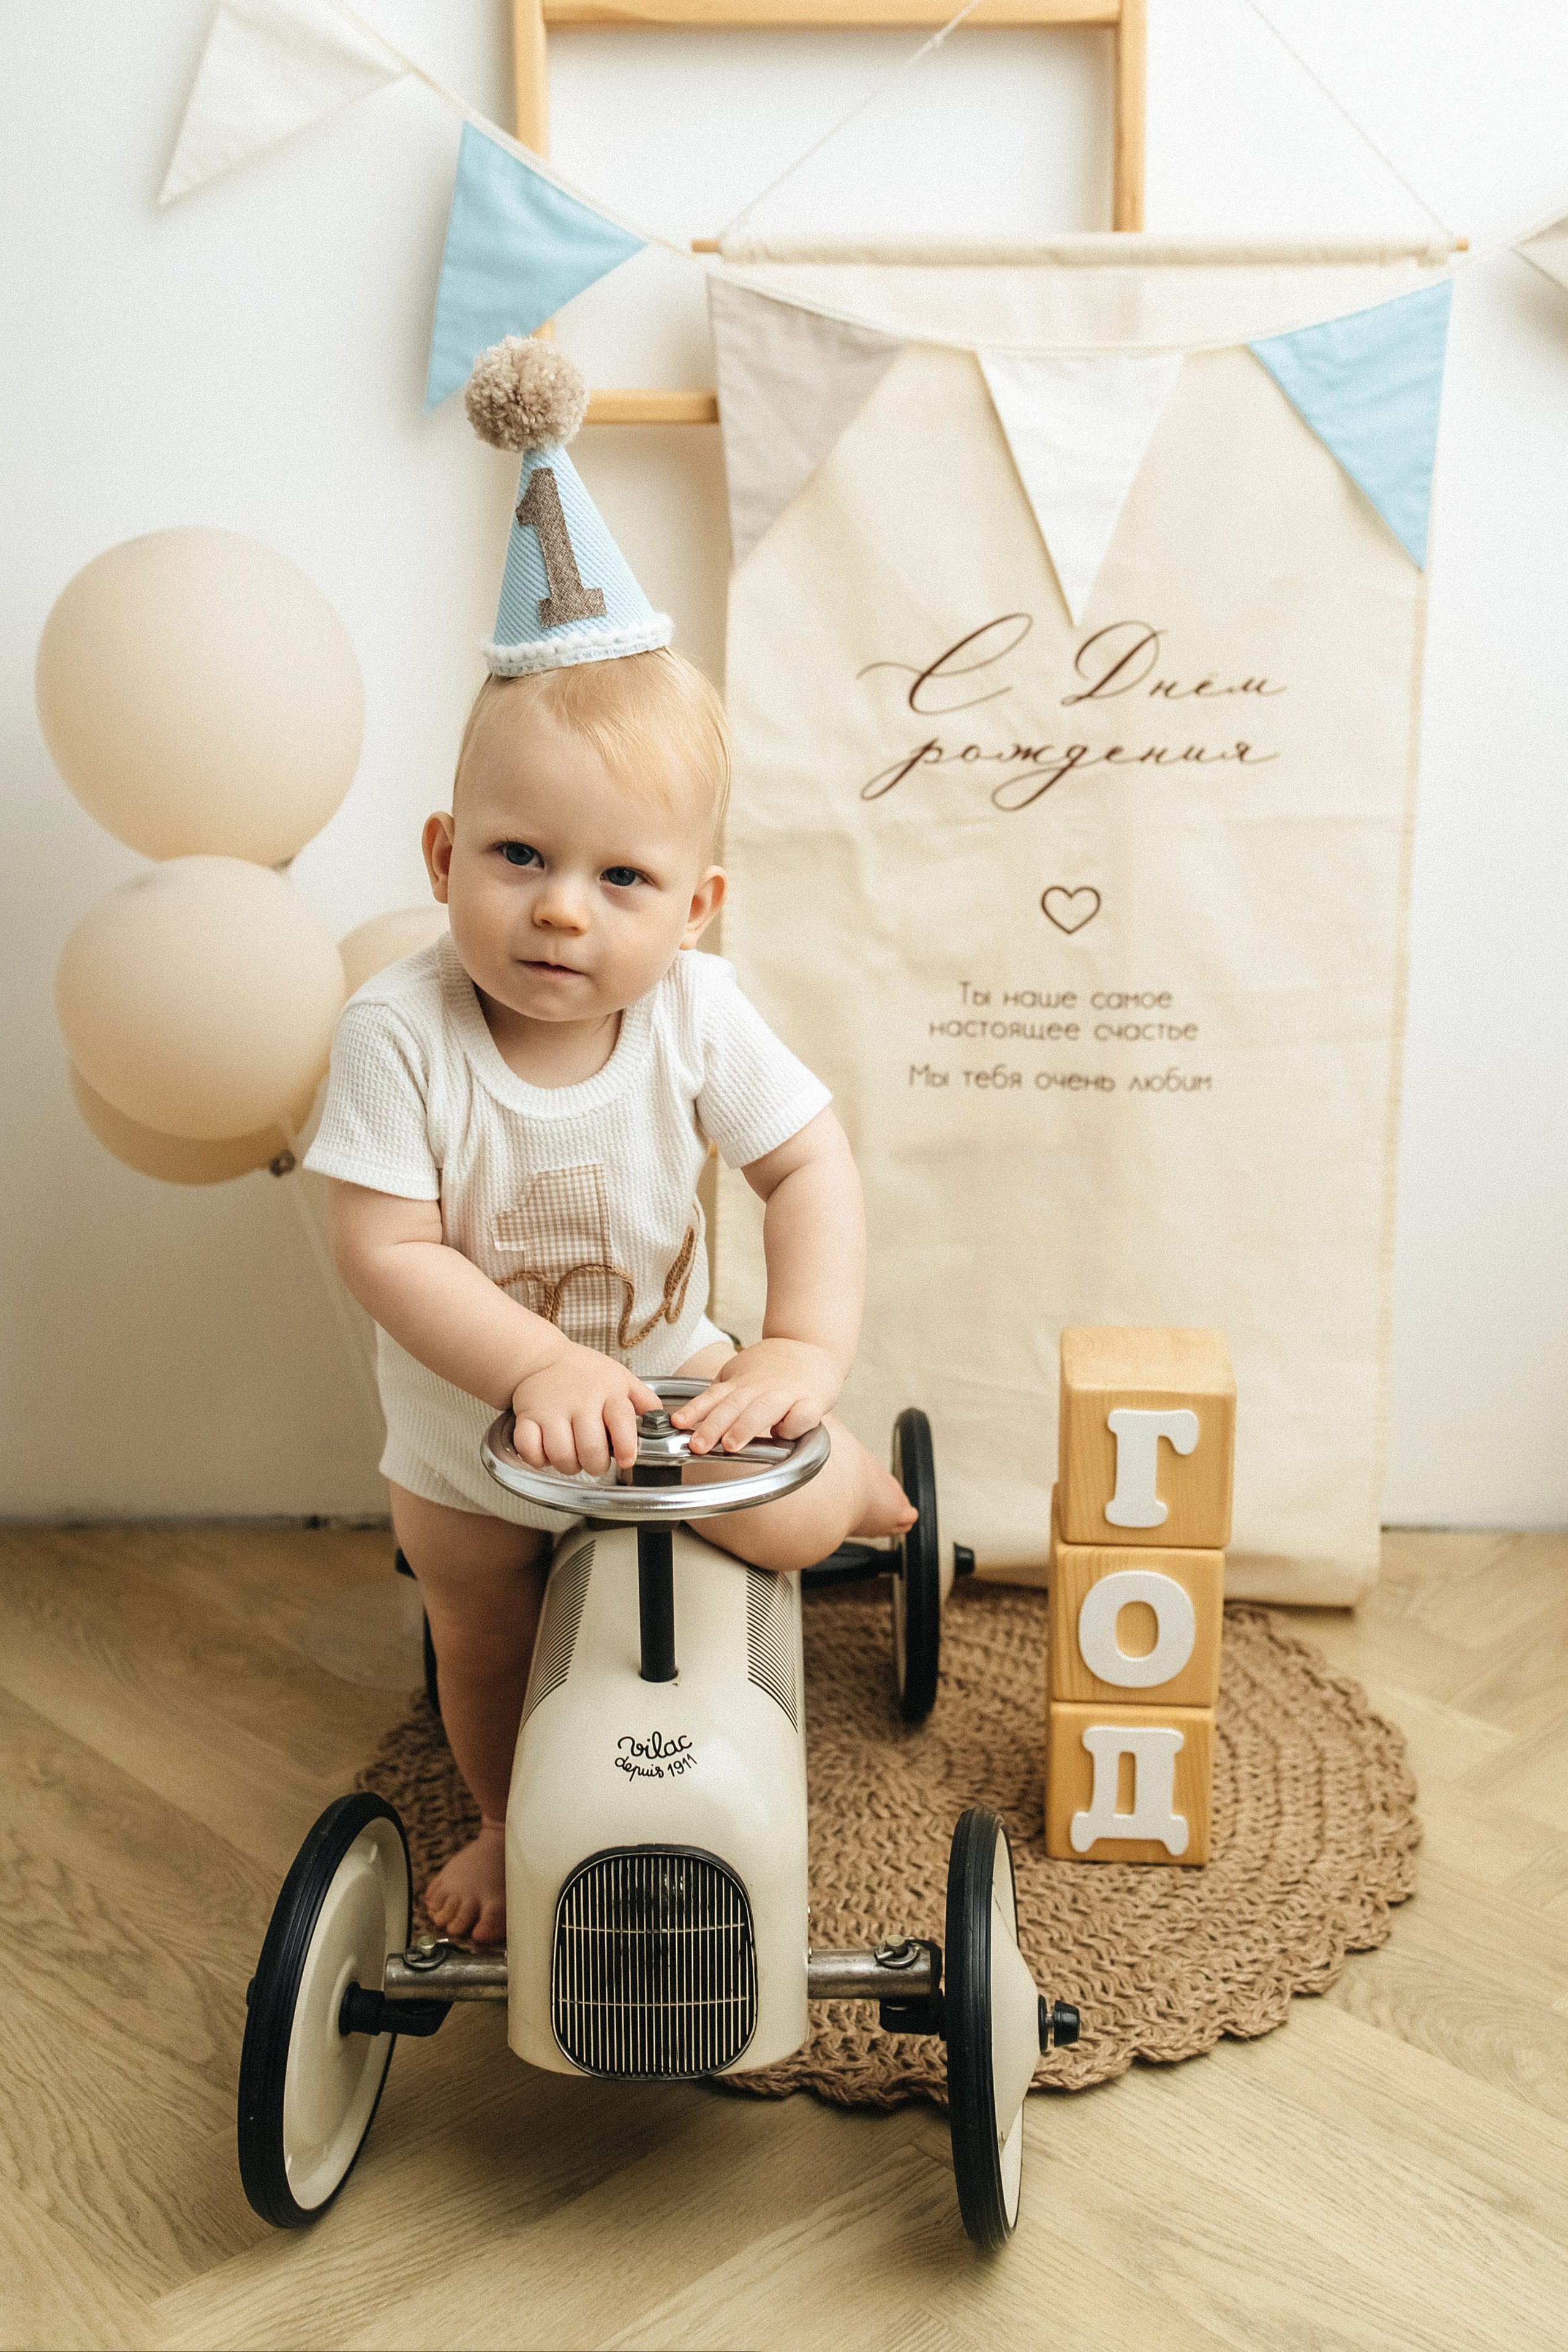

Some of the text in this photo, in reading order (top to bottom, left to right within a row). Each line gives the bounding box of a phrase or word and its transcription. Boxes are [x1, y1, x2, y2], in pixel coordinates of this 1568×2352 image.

[515, 467, 606, 629] 1
[856, 612, 1287, 717] С Днем
[859, 736, 1280, 813] рождения
[959, 980, 1174, 1011] Ты наше самое
[929, 1019, 1199, 1042] настоящее счастье
[908, 1063, 1213, 1093] Мы тебя очень любим
[614, 1754, 698, 1782] depuis 1911
